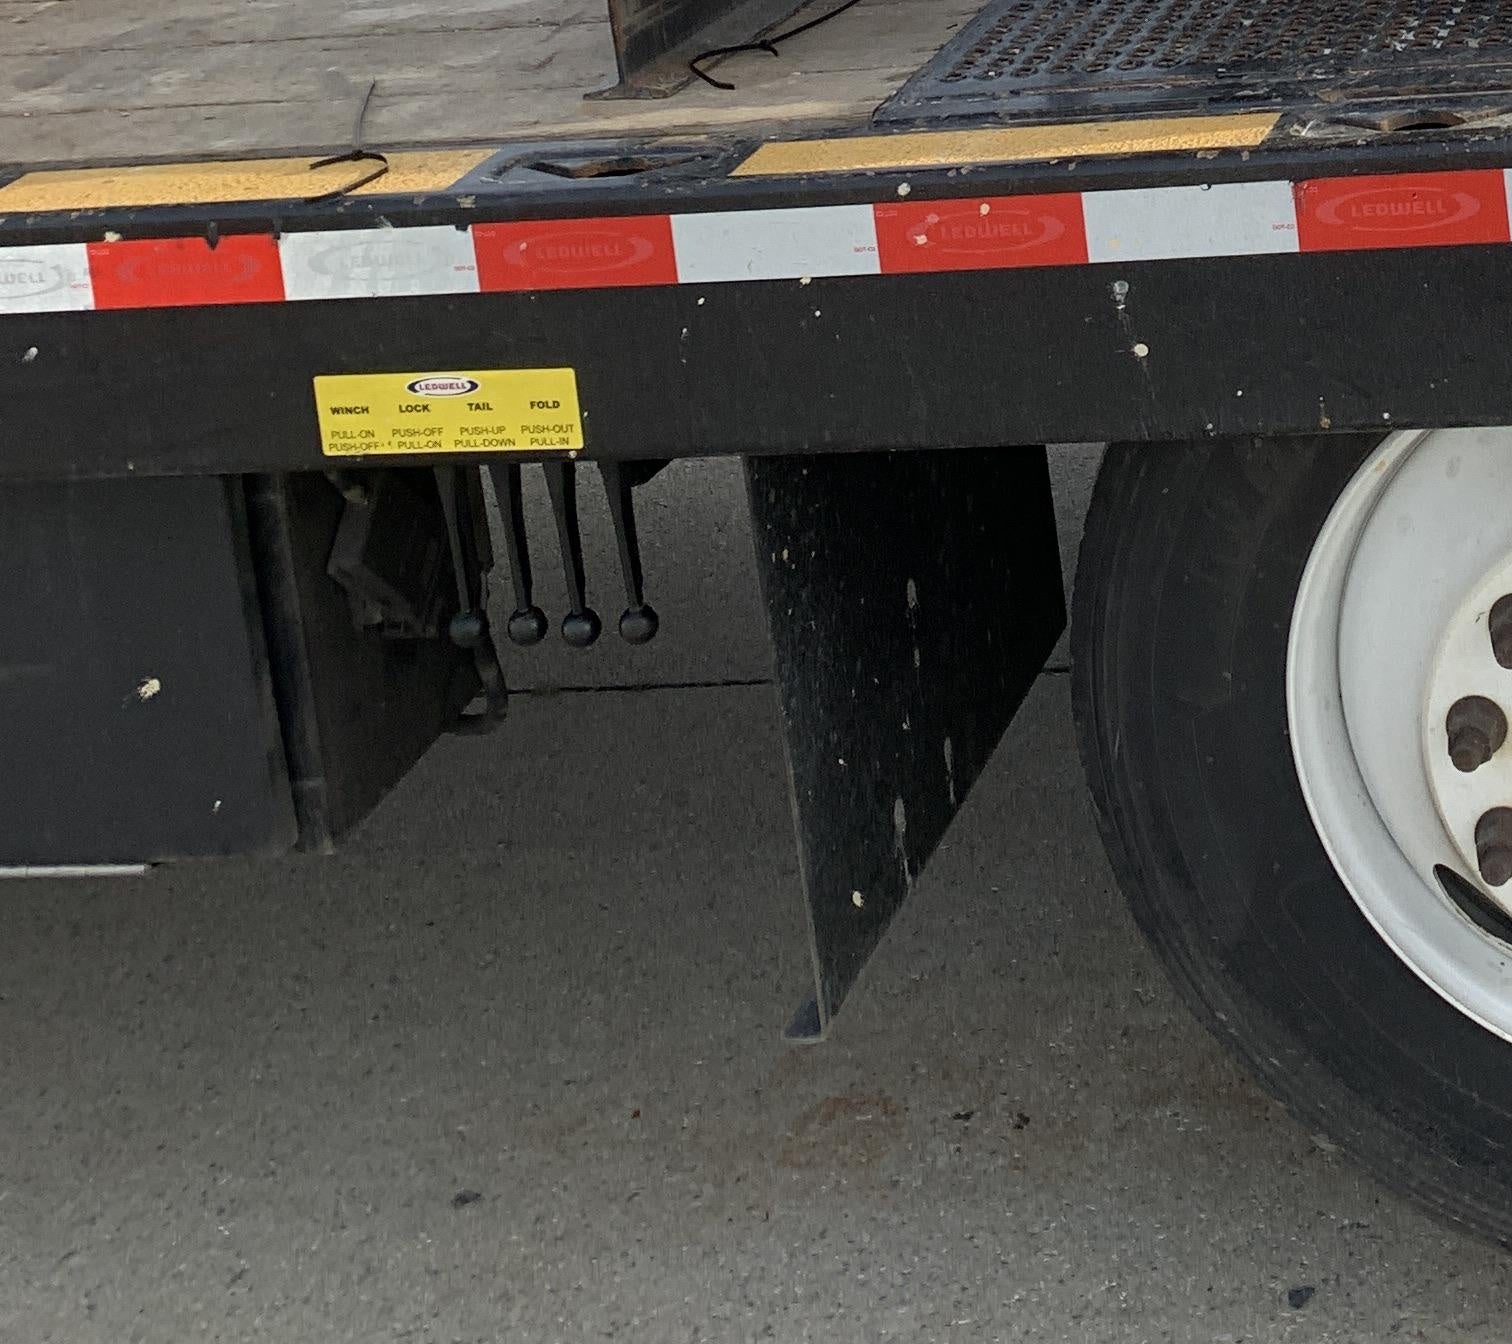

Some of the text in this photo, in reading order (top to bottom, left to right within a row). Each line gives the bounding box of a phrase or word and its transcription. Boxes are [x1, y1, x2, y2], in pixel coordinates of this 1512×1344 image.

[1351, 199, 1447, 217] LEDWELL
[941, 220, 1032, 239] LEDWELL
[536, 243, 623, 259] LEDWELL
[420, 382, 467, 391] LEDWELL
[330, 400, 561, 415] WINCH LOCK TAIL FOLD
[332, 424, 574, 439] PULL-ON PUSH-OFF PUSH-UP PUSH-OUT
[329, 436, 570, 452] PUSH-OFF PULL-ON PULL-DOWN PULL-IN
